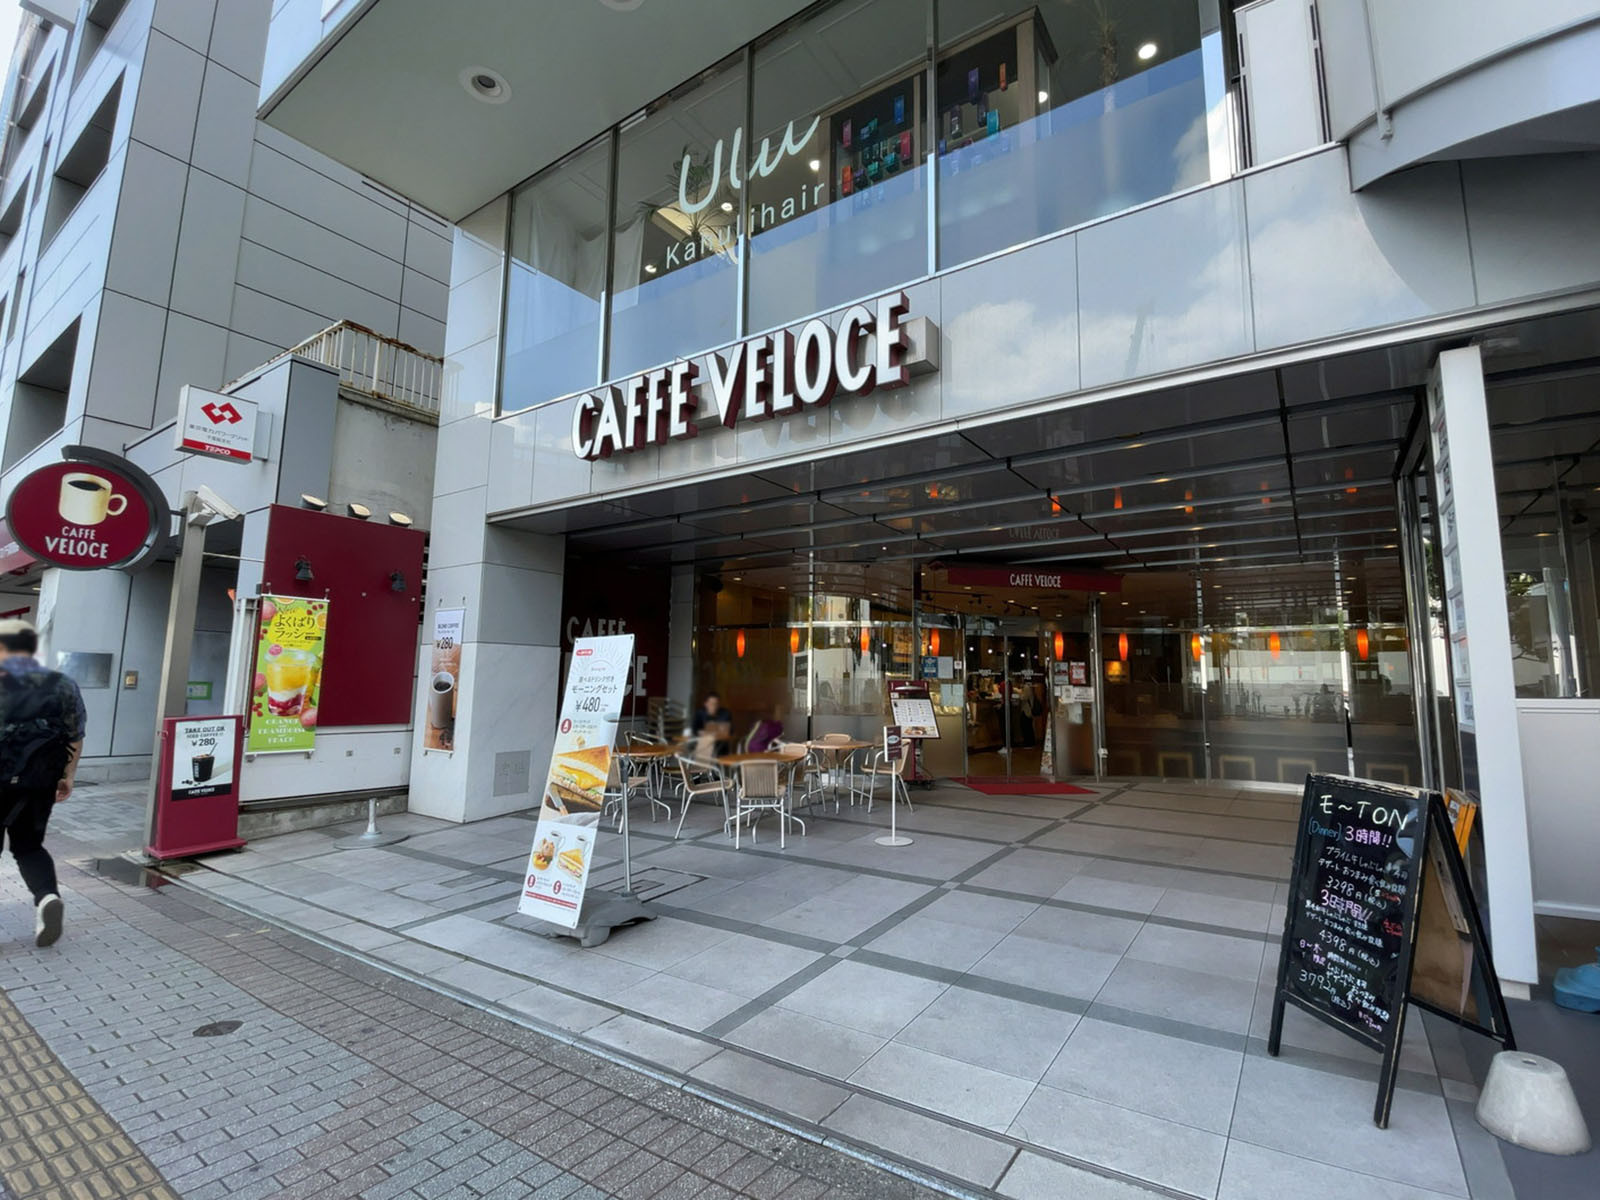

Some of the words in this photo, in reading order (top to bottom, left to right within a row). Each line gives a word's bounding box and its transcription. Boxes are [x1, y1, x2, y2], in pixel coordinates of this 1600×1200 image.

[705, 290, 908, 428] VELOCE
[204, 445, 231, 455] TEPCO
[45, 535, 109, 559] VELOCE
[1034, 574, 1061, 588] VELOCE
[274, 614, 316, 629] よくばり
[572, 684, 618, 694] モーニングセット
[576, 697, 601, 712] ¥480
